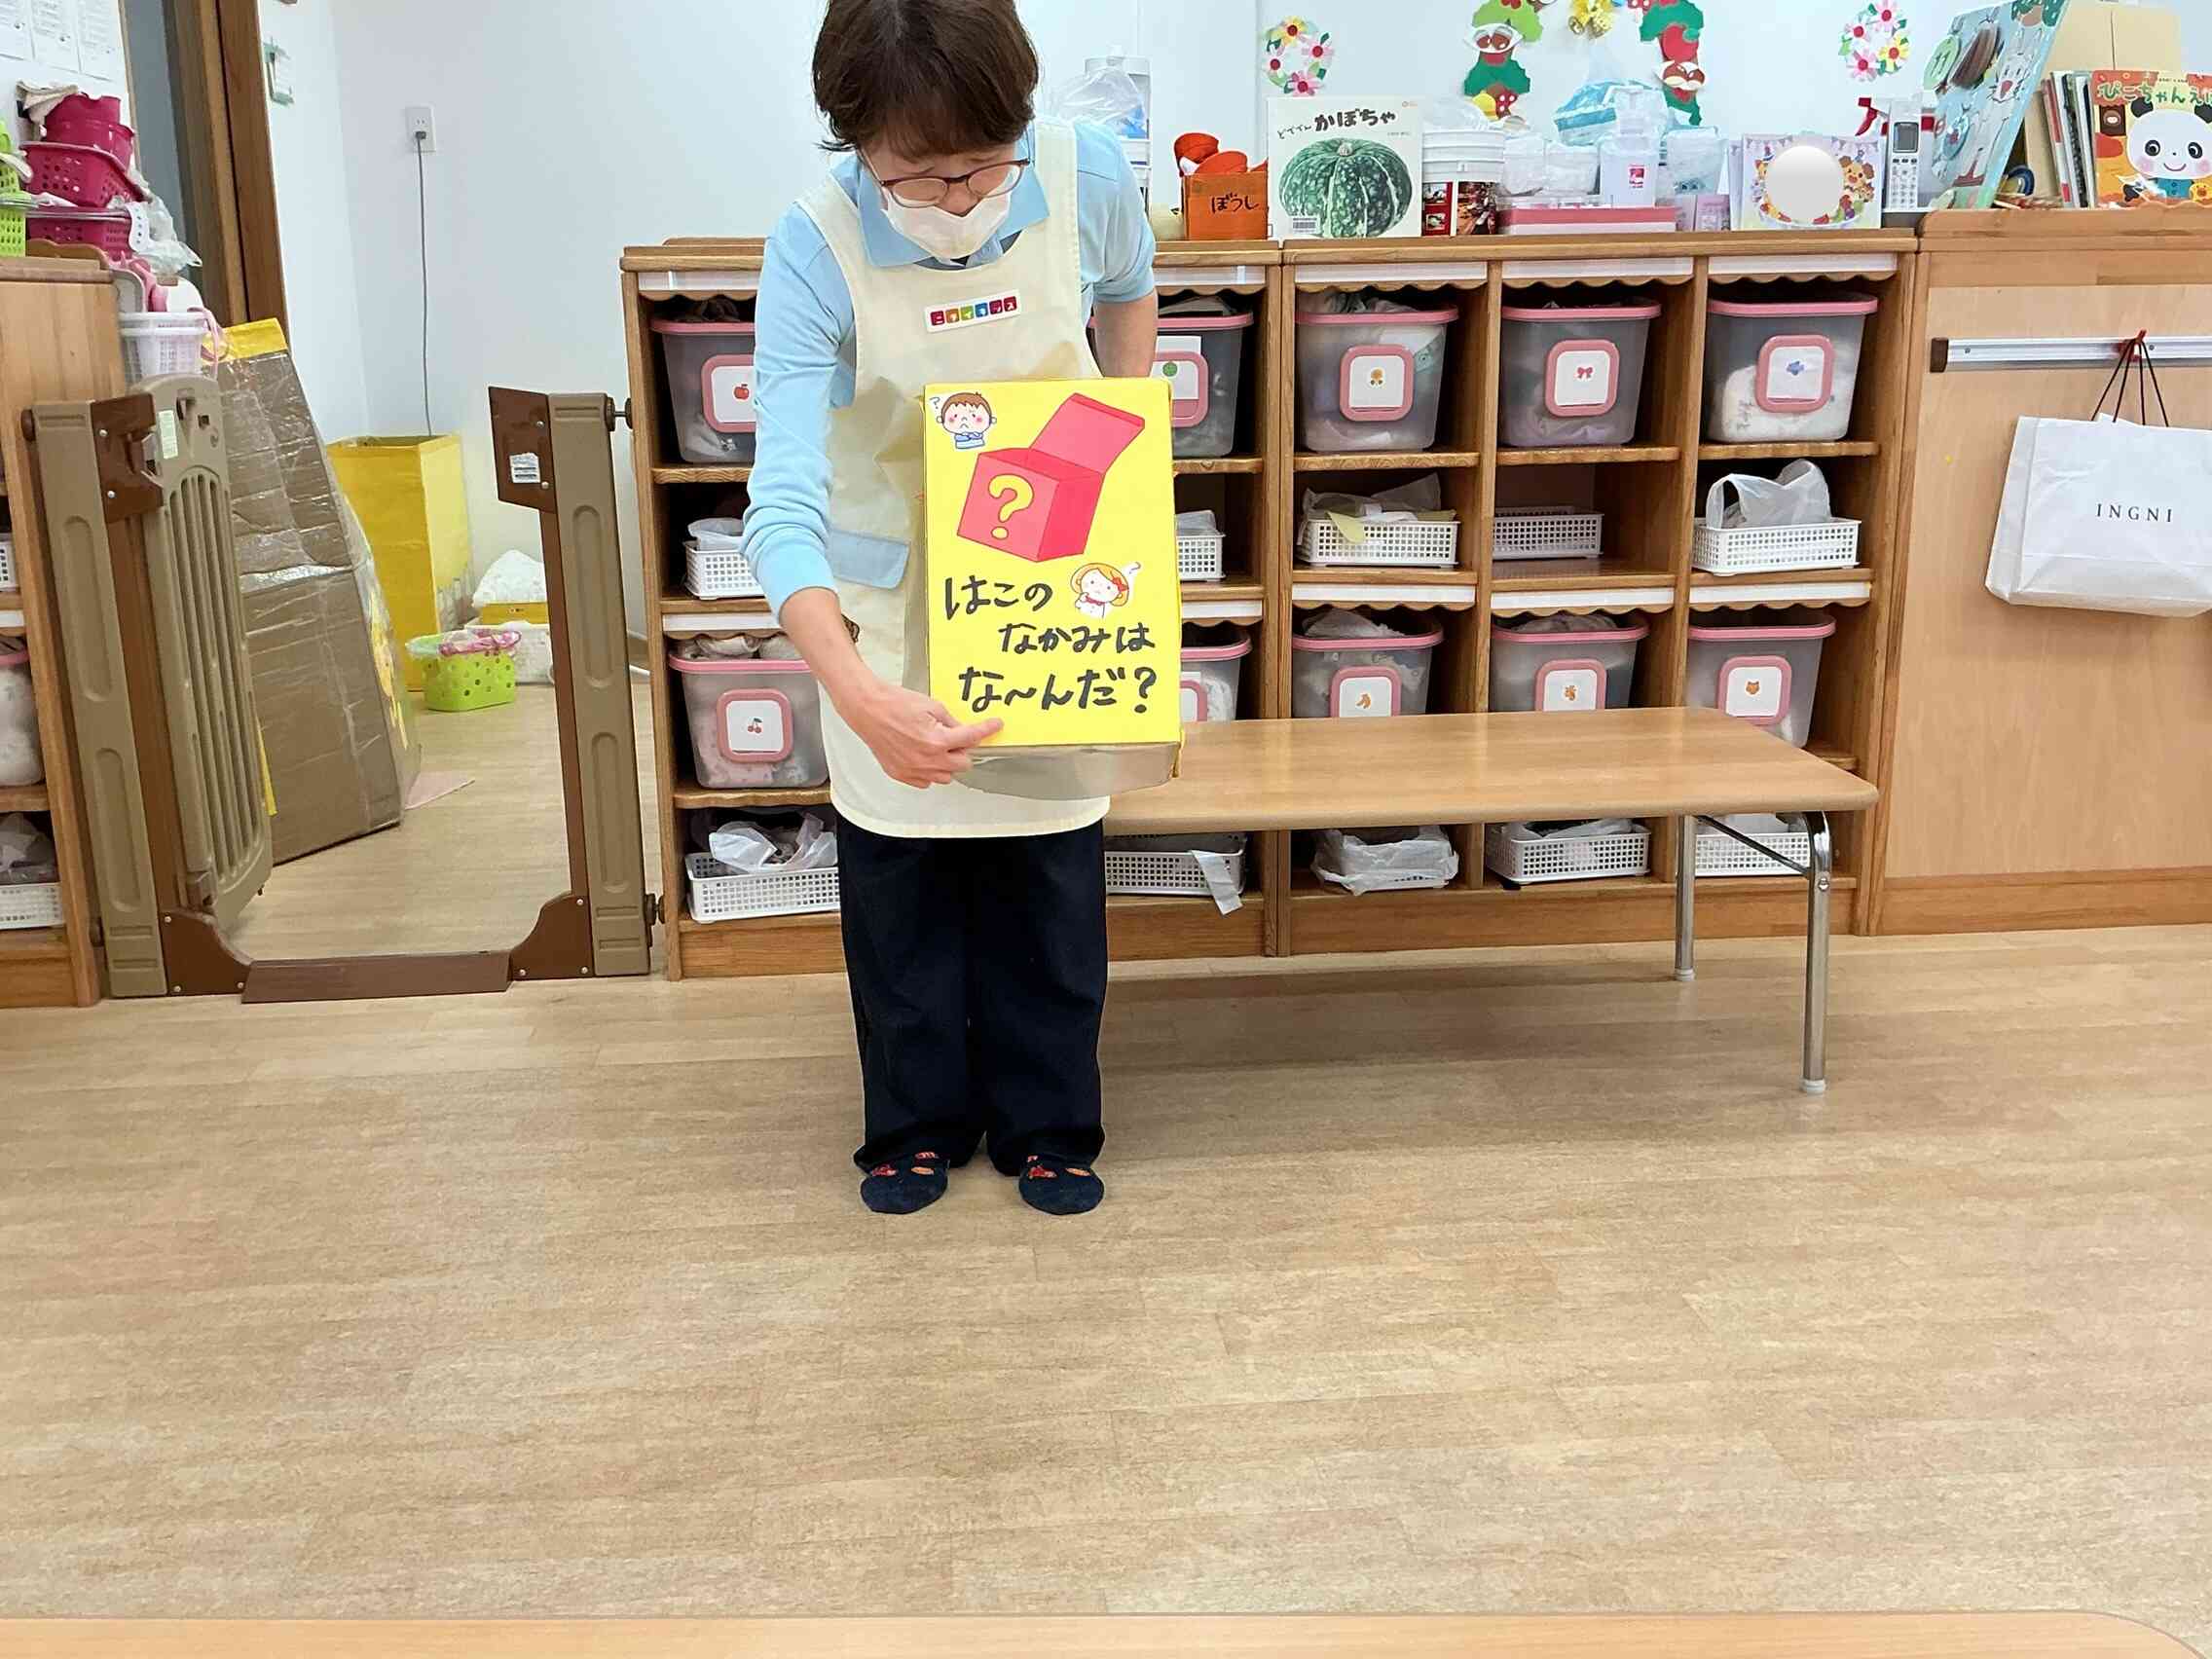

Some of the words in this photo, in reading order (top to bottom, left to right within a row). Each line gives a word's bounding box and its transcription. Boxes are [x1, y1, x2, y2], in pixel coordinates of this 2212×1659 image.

[1314, 108, 1396, 131] かぼちゃ
[1211, 192, 1260, 213] ぼうし
[2096, 503, 2172, 523] INGNI
[944, 575, 1053, 620] はこの
[998, 622, 1156, 654] なかみは
